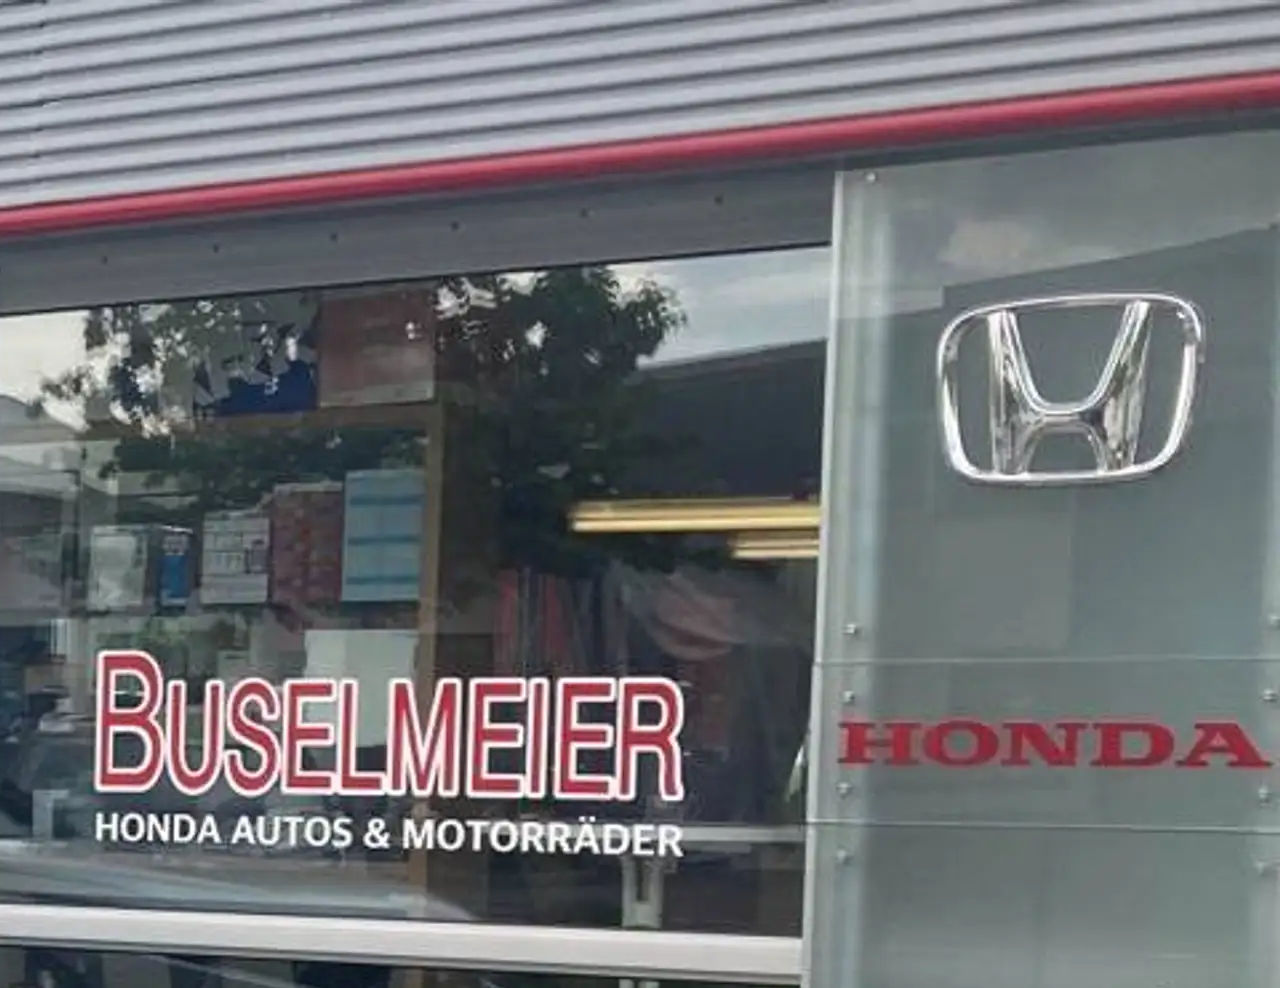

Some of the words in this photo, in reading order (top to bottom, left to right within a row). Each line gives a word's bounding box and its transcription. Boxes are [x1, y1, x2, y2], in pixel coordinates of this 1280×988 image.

[93, 649, 685, 801] BUSELMEIER
[836, 720, 1273, 769] HONDA
[94, 812, 221, 844] HONDA
[231, 815, 352, 849] AUTOS
[362, 818, 391, 848] &
[401, 815, 685, 858] MOTORRÄDER
